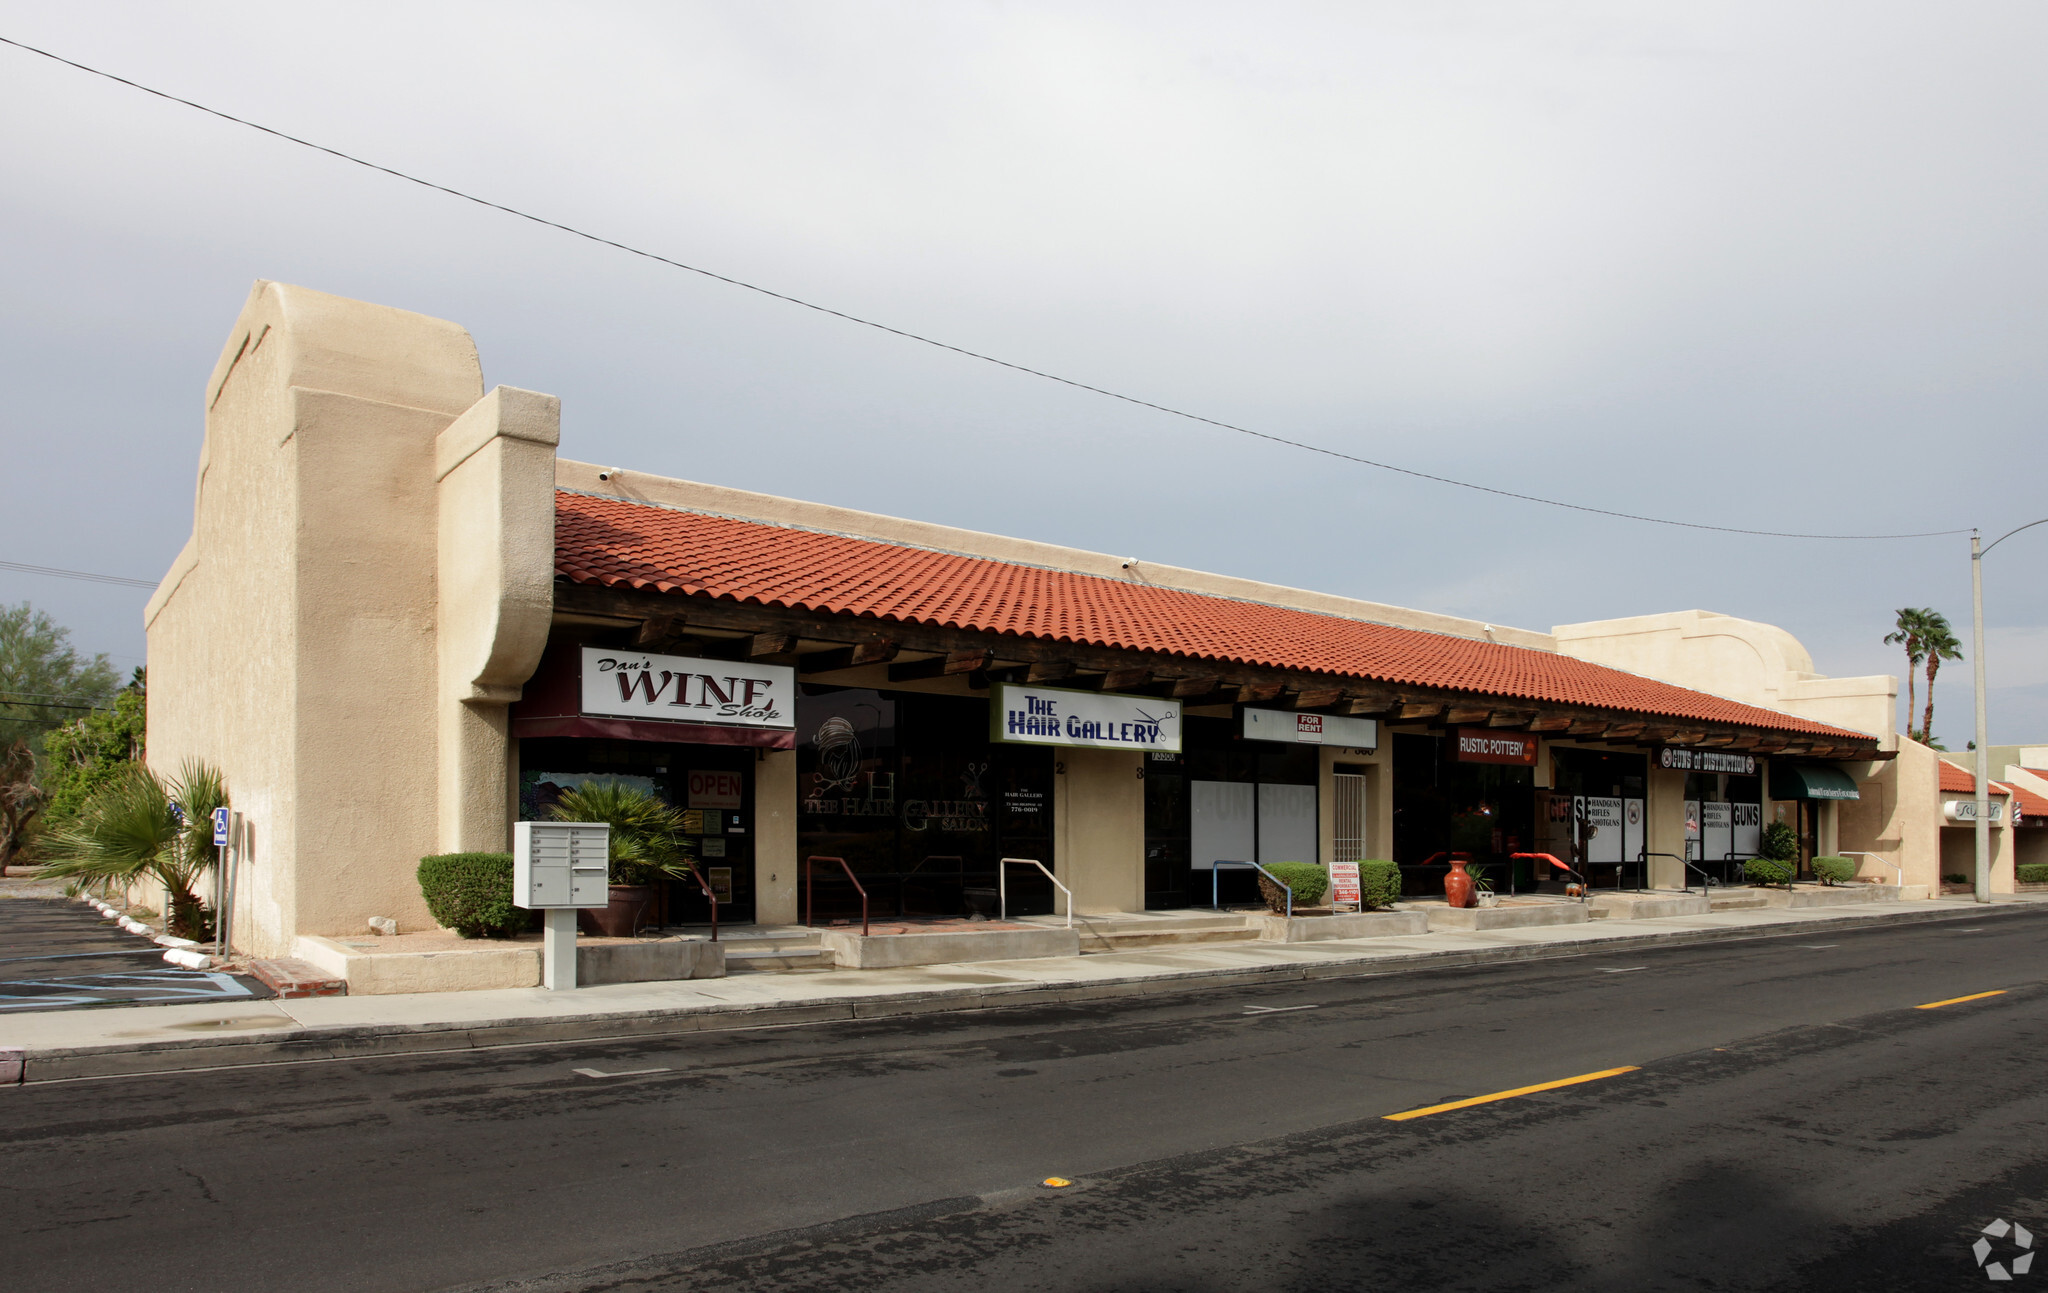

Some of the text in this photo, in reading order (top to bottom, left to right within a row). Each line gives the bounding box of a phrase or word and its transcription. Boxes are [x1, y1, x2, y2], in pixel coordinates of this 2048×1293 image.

[597, 656, 653, 672] Dan's
[615, 670, 773, 712] WINE
[716, 704, 782, 722] Shop
[1301, 716, 1319, 725] FOR
[1008, 710, 1159, 744] HAIR GALLERY
[1298, 723, 1322, 733] RENT
[1460, 737, 1524, 756] RUSTIC POTTERY
[1056, 762, 1066, 775] 2
[1672, 749, 1746, 773] GUNS of DISTINCTION
[1136, 767, 1145, 780] 3
[690, 774, 742, 796] OPEN
[840, 797, 897, 816] HAIR
[1591, 800, 1621, 808] HANDGUNS
[1591, 809, 1611, 817] RIFLES
[1706, 812, 1722, 820] RIFLES
[1734, 805, 1759, 826] GUNS
[941, 817, 990, 832] SALON
